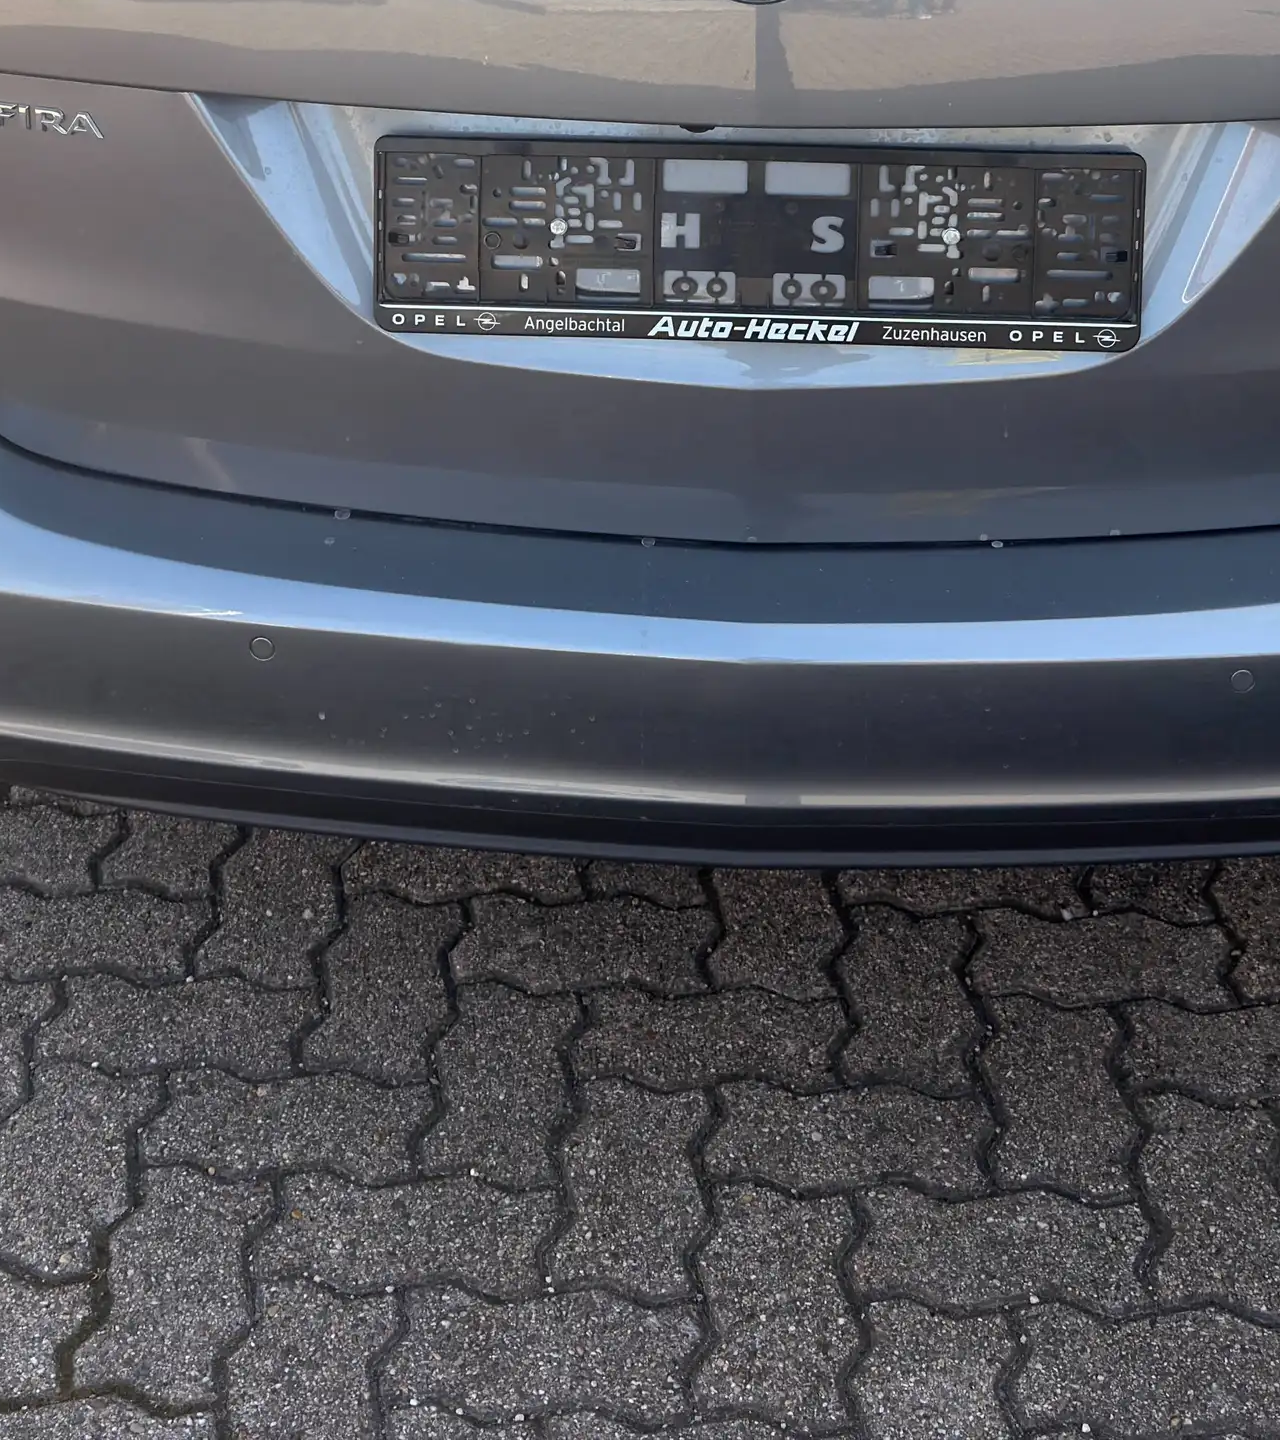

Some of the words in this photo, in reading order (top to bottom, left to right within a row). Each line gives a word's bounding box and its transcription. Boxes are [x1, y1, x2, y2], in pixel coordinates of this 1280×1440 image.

[391, 312, 467, 328] OPEL
[523, 315, 626, 334] Angelbachtal
[647, 315, 860, 343] Auto-Heckel
[881, 325, 987, 344] Zuzenhausen
[1008, 329, 1086, 345] OPEL
